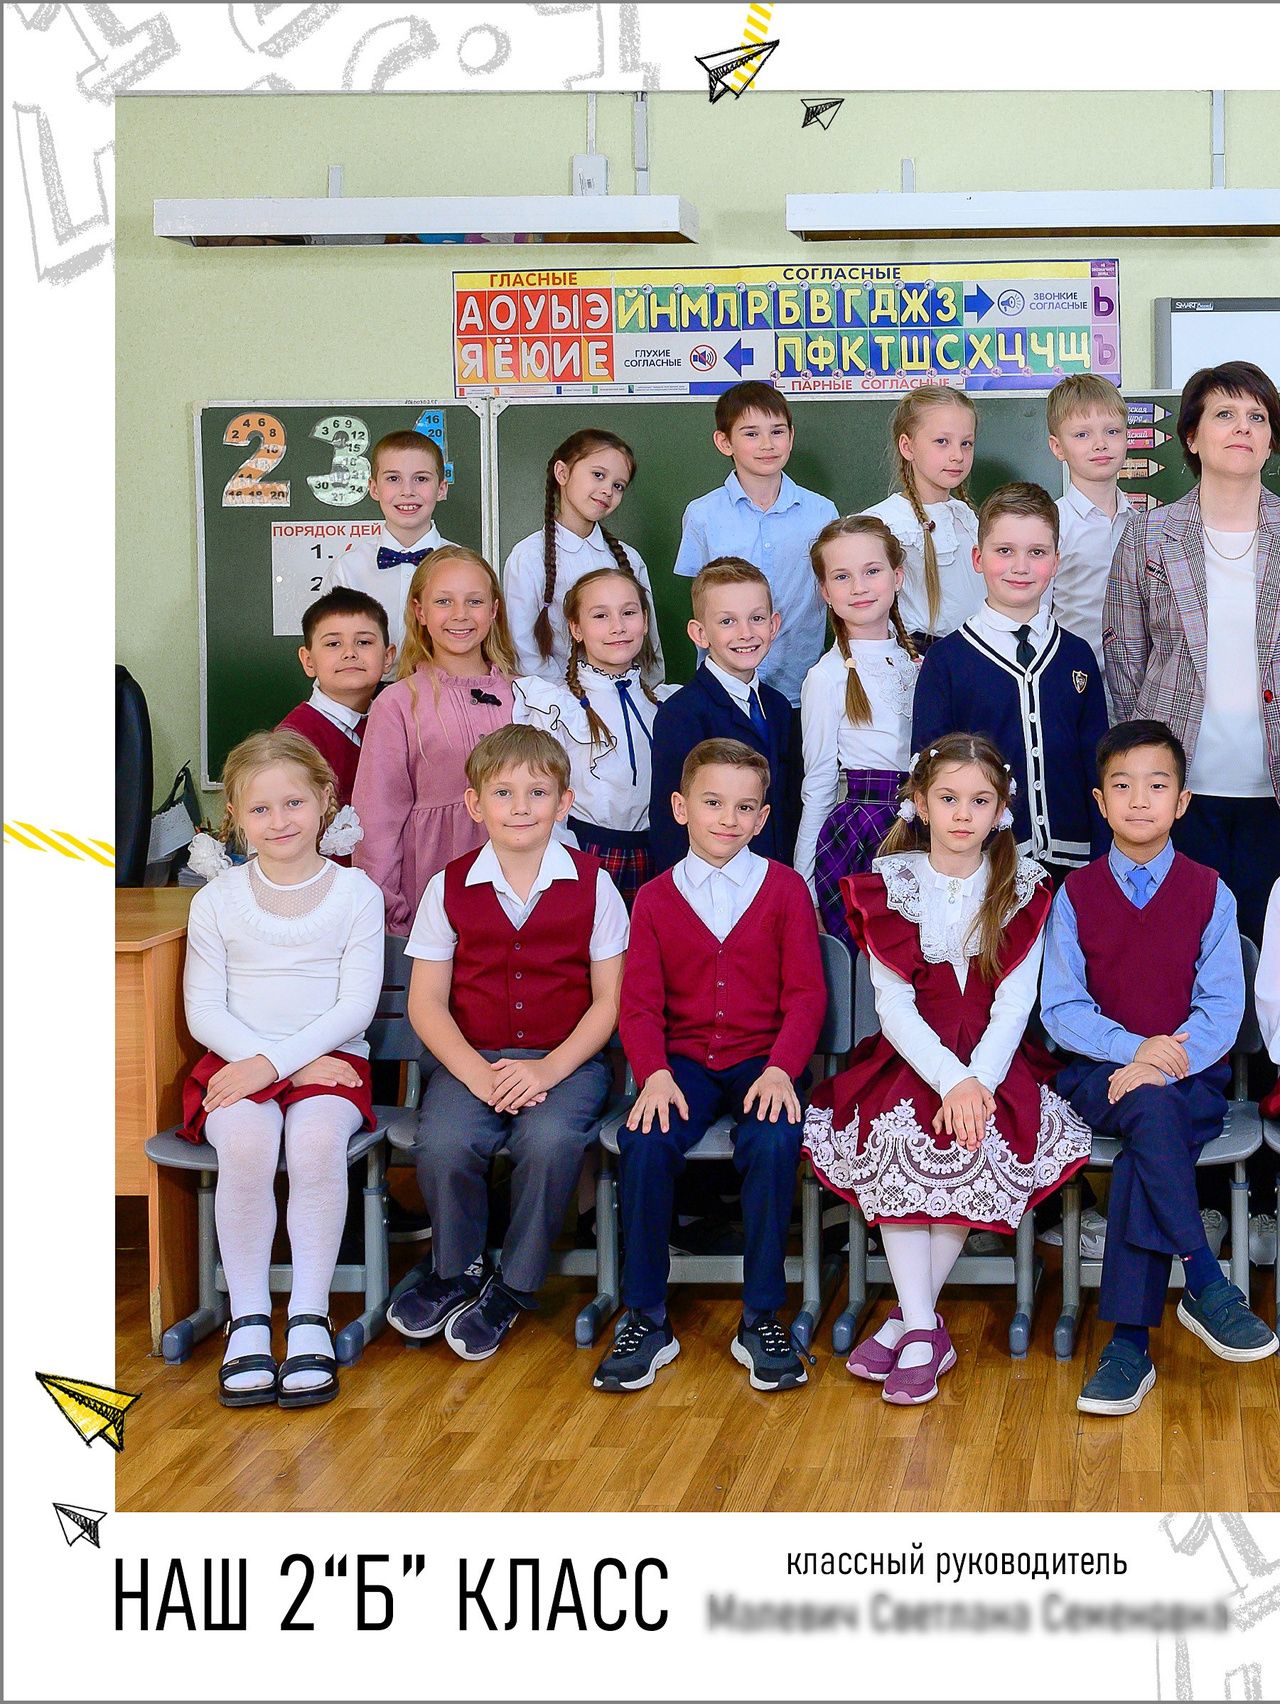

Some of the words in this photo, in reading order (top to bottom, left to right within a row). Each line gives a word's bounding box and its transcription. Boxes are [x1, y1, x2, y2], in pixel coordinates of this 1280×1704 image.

[783, 266, 901, 281] СОГЛАСНЫЕ
[490, 272, 578, 287] ГЛАСНЫЕ
[1033, 291, 1078, 301] ЗВОНКИЕ
[1029, 300, 1088, 311] СОГЛАСНЫЕ
[635, 349, 671, 359] ГЛУХИЕ
[623, 358, 682, 368] СОГЛАСНЫЕ
[791, 379, 853, 391] ПАРНЫЕ
[861, 378, 950, 390] СОГЛАСНЫЕ
[243, 419, 250, 428] 4
[258, 418, 266, 427] 6
[333, 420, 340, 428] 6
[345, 420, 352, 429] 9
[425, 415, 440, 424] 16
[231, 430, 239, 439] 2
[269, 428, 277, 437] 8
[322, 426, 329, 435] 3
[351, 431, 365, 440] 12
[428, 429, 442, 438] 20
[315, 481, 329, 490] 30
[273, 525, 346, 538] ПОРЯДОК
[350, 523, 382, 537] ДЕЙ
